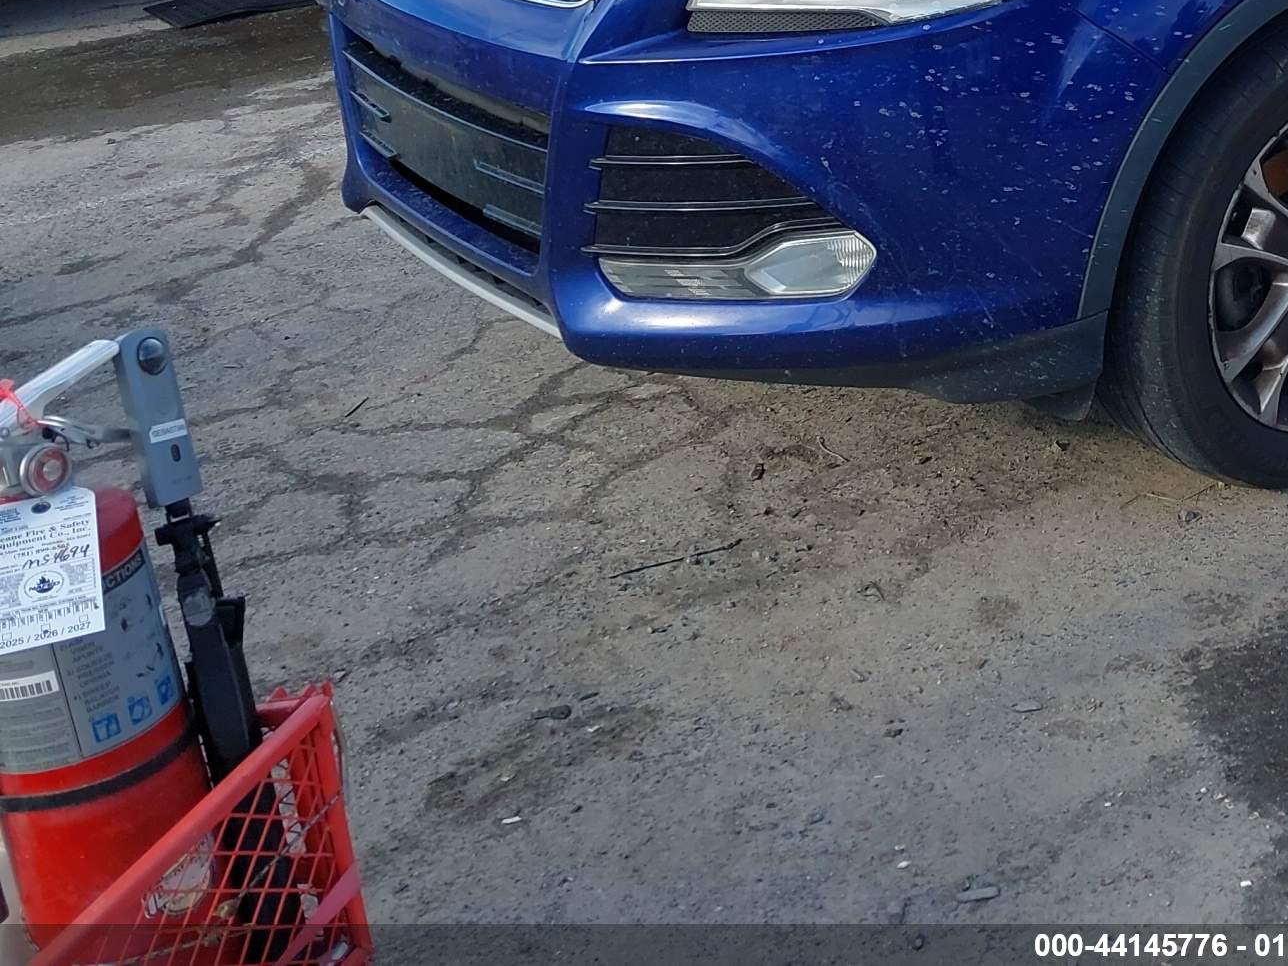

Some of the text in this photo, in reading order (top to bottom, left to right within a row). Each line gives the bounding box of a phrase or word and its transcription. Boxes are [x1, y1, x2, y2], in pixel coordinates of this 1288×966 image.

[103, 553, 142, 589] CTIONS
[0, 636, 24, 649] 2025
[34, 629, 58, 641] 2026
[67, 622, 91, 634] 2027
